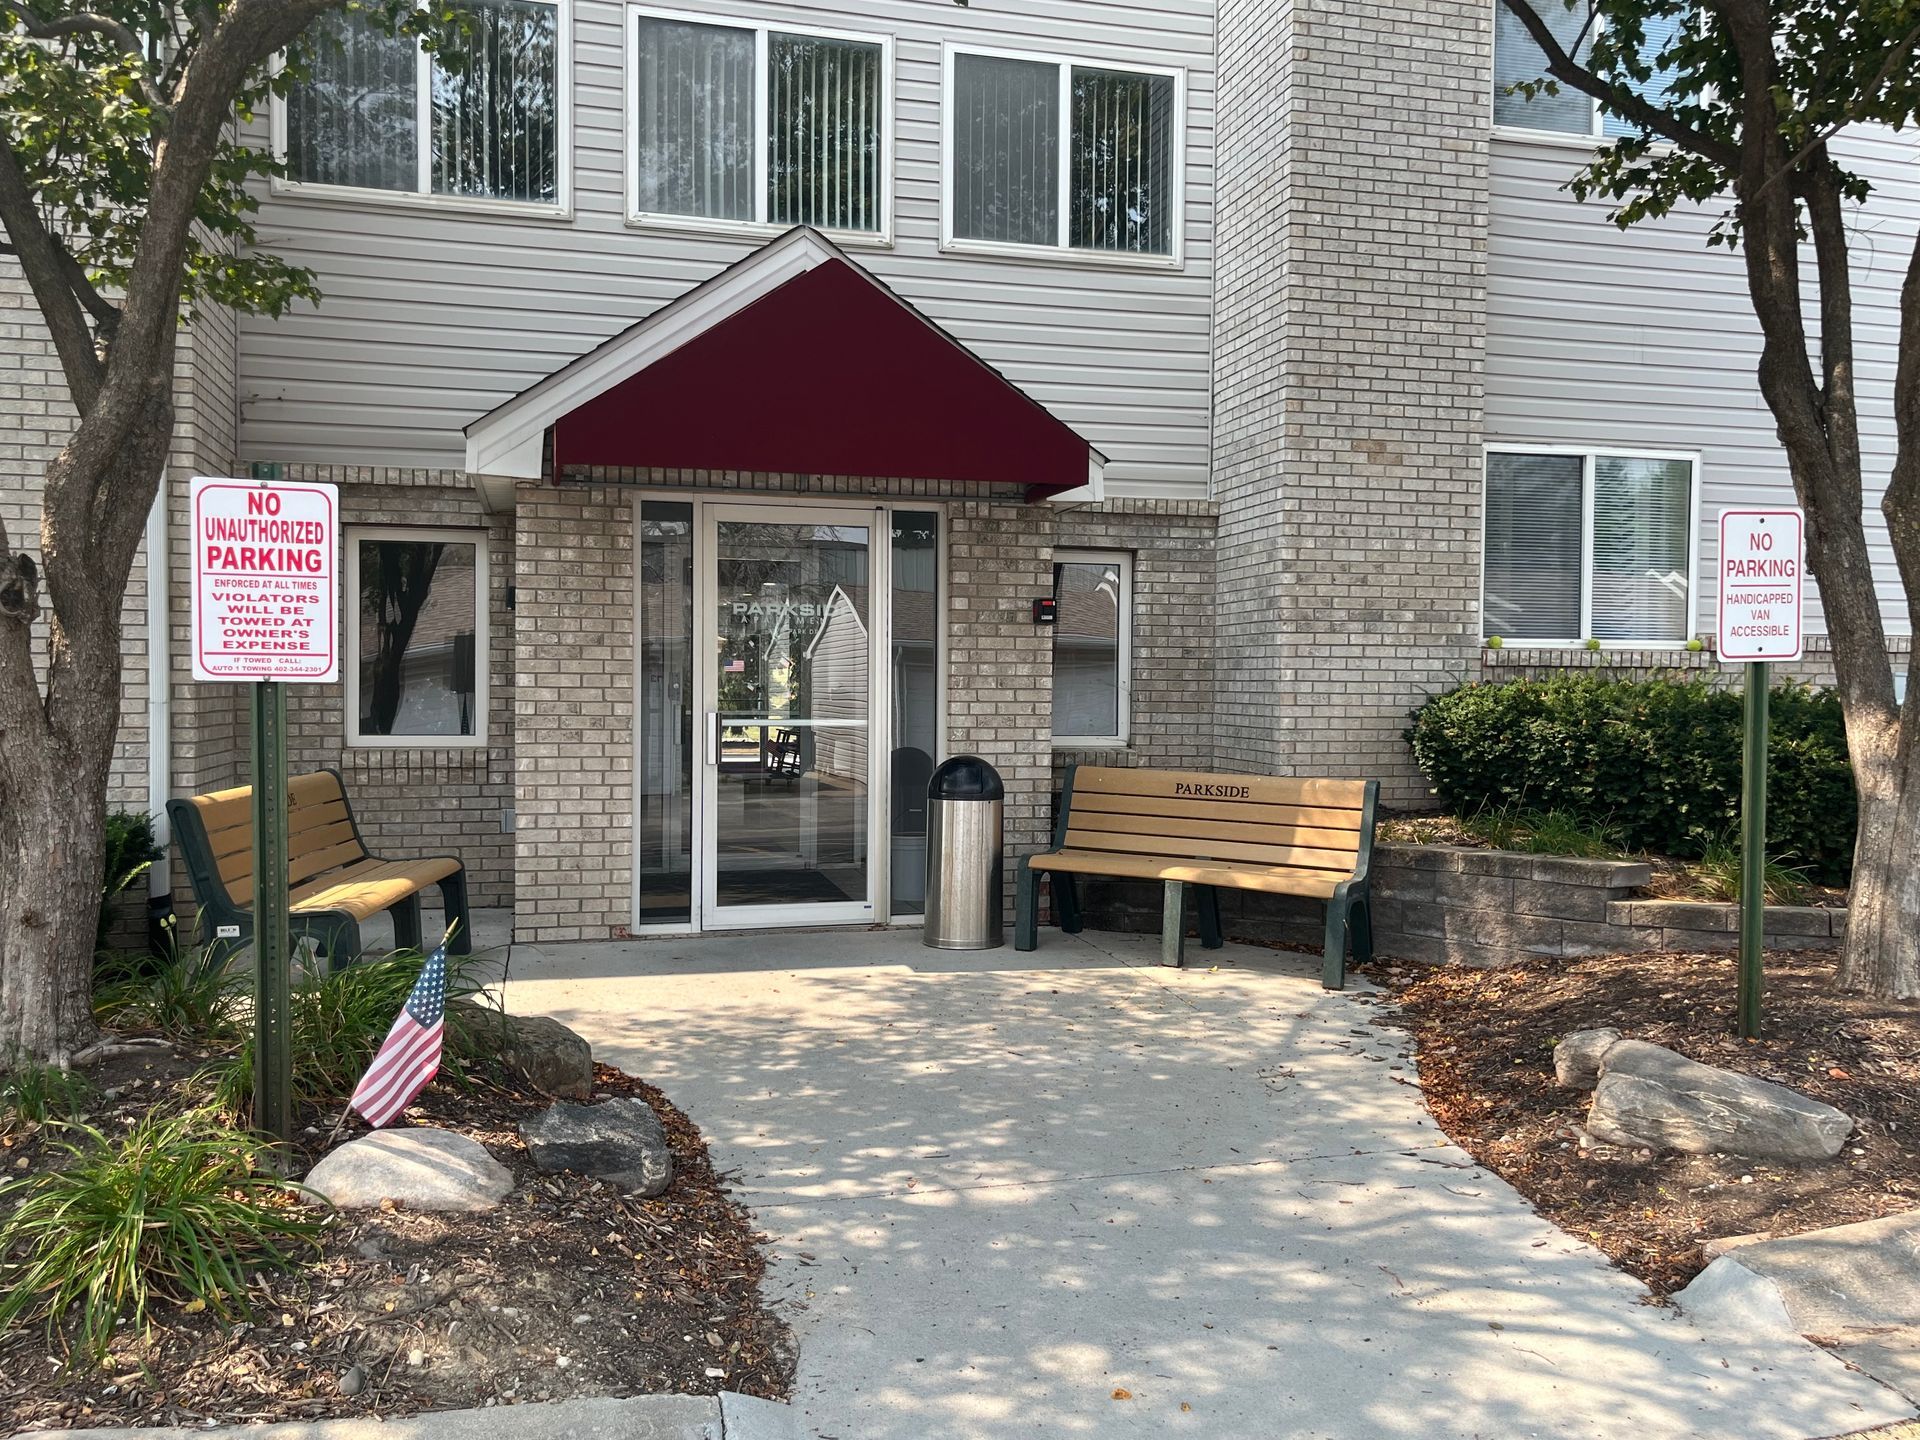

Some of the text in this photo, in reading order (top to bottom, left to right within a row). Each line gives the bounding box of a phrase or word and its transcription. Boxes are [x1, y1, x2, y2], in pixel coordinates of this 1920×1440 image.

[248, 491, 281, 516] NO
[205, 517, 324, 545] UNAUTHORIZED
[1750, 532, 1773, 551] NO
[207, 546, 322, 572] PARKING
[1726, 559, 1795, 577] PARKING
[214, 579, 318, 590] ENFORCED AT ALL TIMES
[212, 593, 319, 603] VIOLATORS
[1726, 593, 1793, 604] HANDICAPPED
[227, 605, 304, 615] WILL BE
[732, 602, 837, 617] PARKSID
[1751, 609, 1770, 620] VAN
[217, 616, 314, 627] TOWED AT
[223, 628, 310, 638] OWNER'S
[1730, 625, 1789, 637] ACCESSIBLE
[223, 640, 310, 650] EXPENSE
[1175, 782, 1250, 798] PARKSIDE
